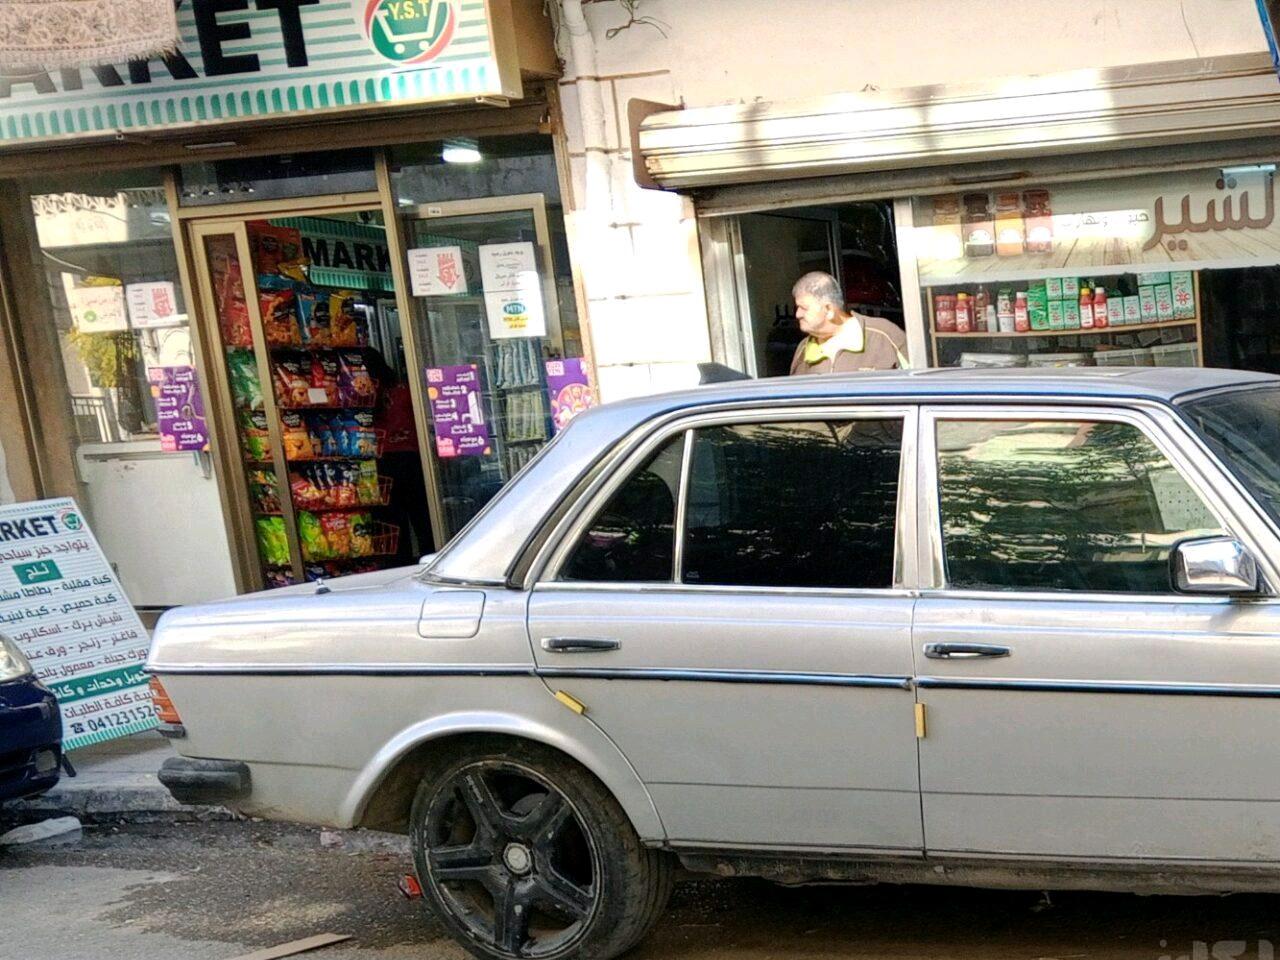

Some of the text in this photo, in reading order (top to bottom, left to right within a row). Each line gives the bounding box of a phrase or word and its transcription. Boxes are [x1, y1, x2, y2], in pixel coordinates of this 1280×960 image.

[0, 515, 59, 542] RKET
[25, 562, 50, 580] ثلج
[93, 574, 112, 586] كبة
[95, 593, 117, 605] كبة
[26, 605, 50, 619] كبة
